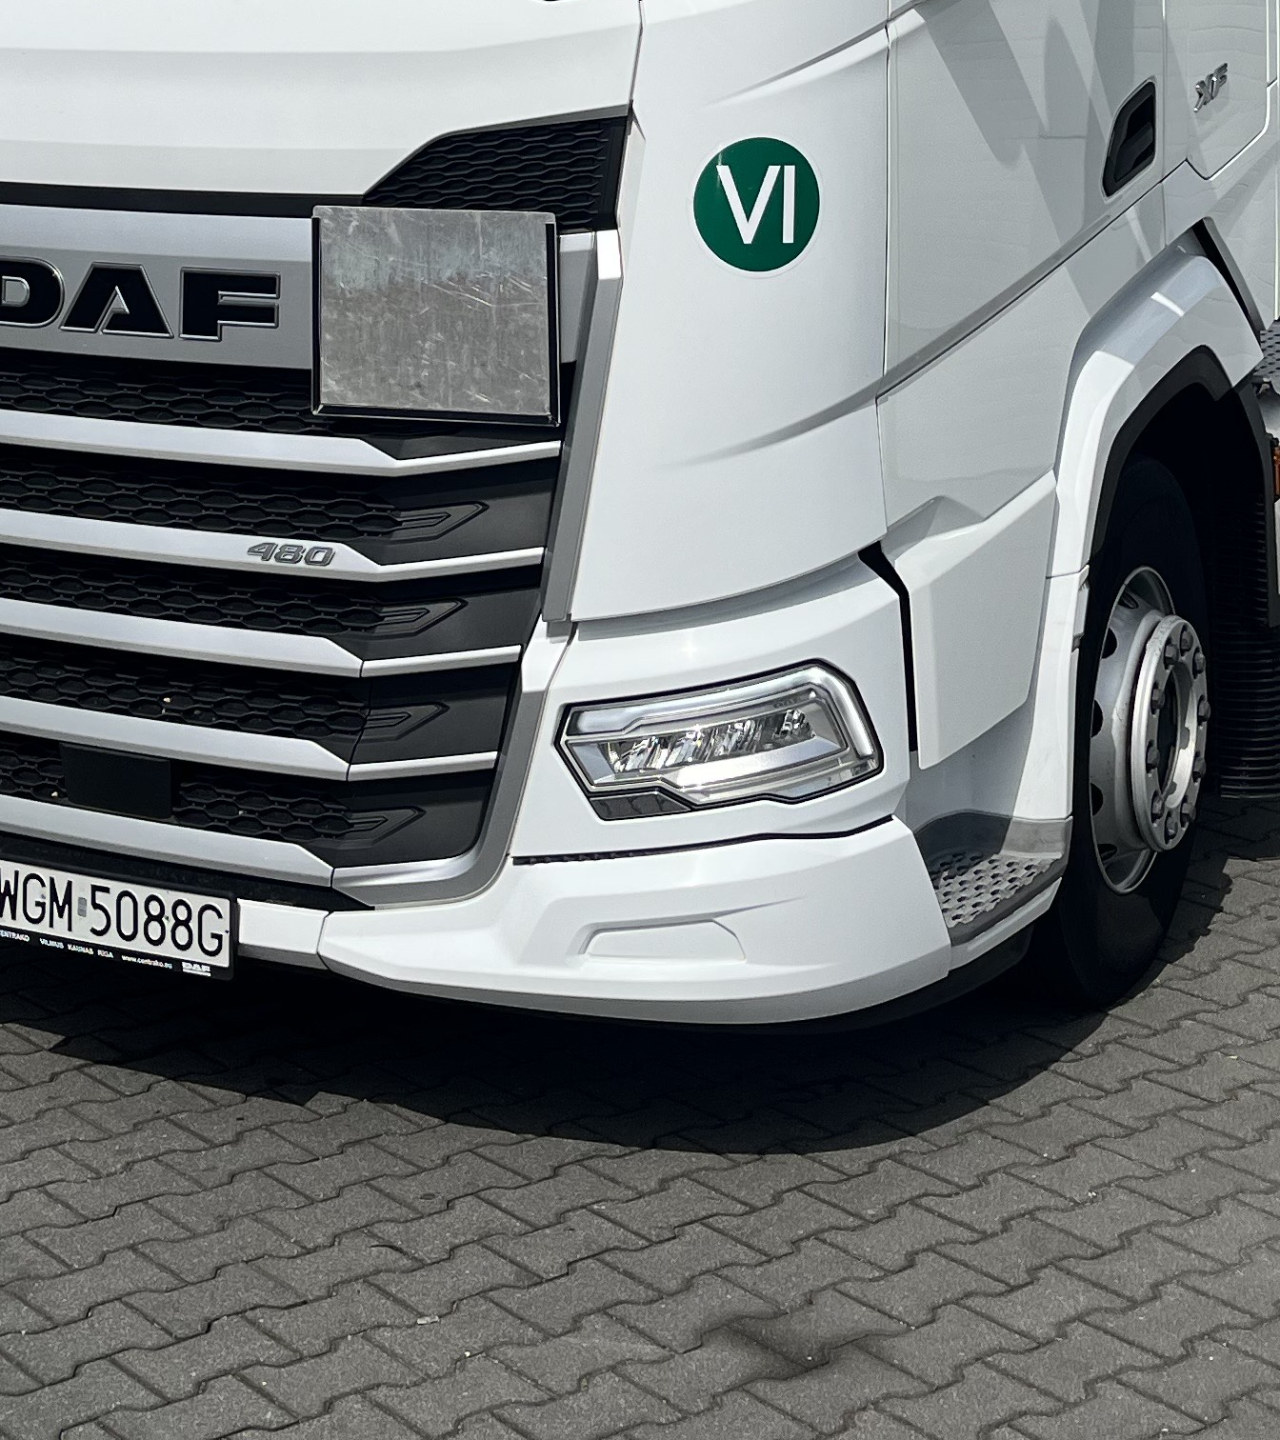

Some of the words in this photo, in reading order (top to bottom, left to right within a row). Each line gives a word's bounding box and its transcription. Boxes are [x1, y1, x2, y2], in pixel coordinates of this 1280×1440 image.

[716, 165, 795, 244] VI
[247, 542, 336, 567] 480
[90, 884, 224, 957] 5088G
